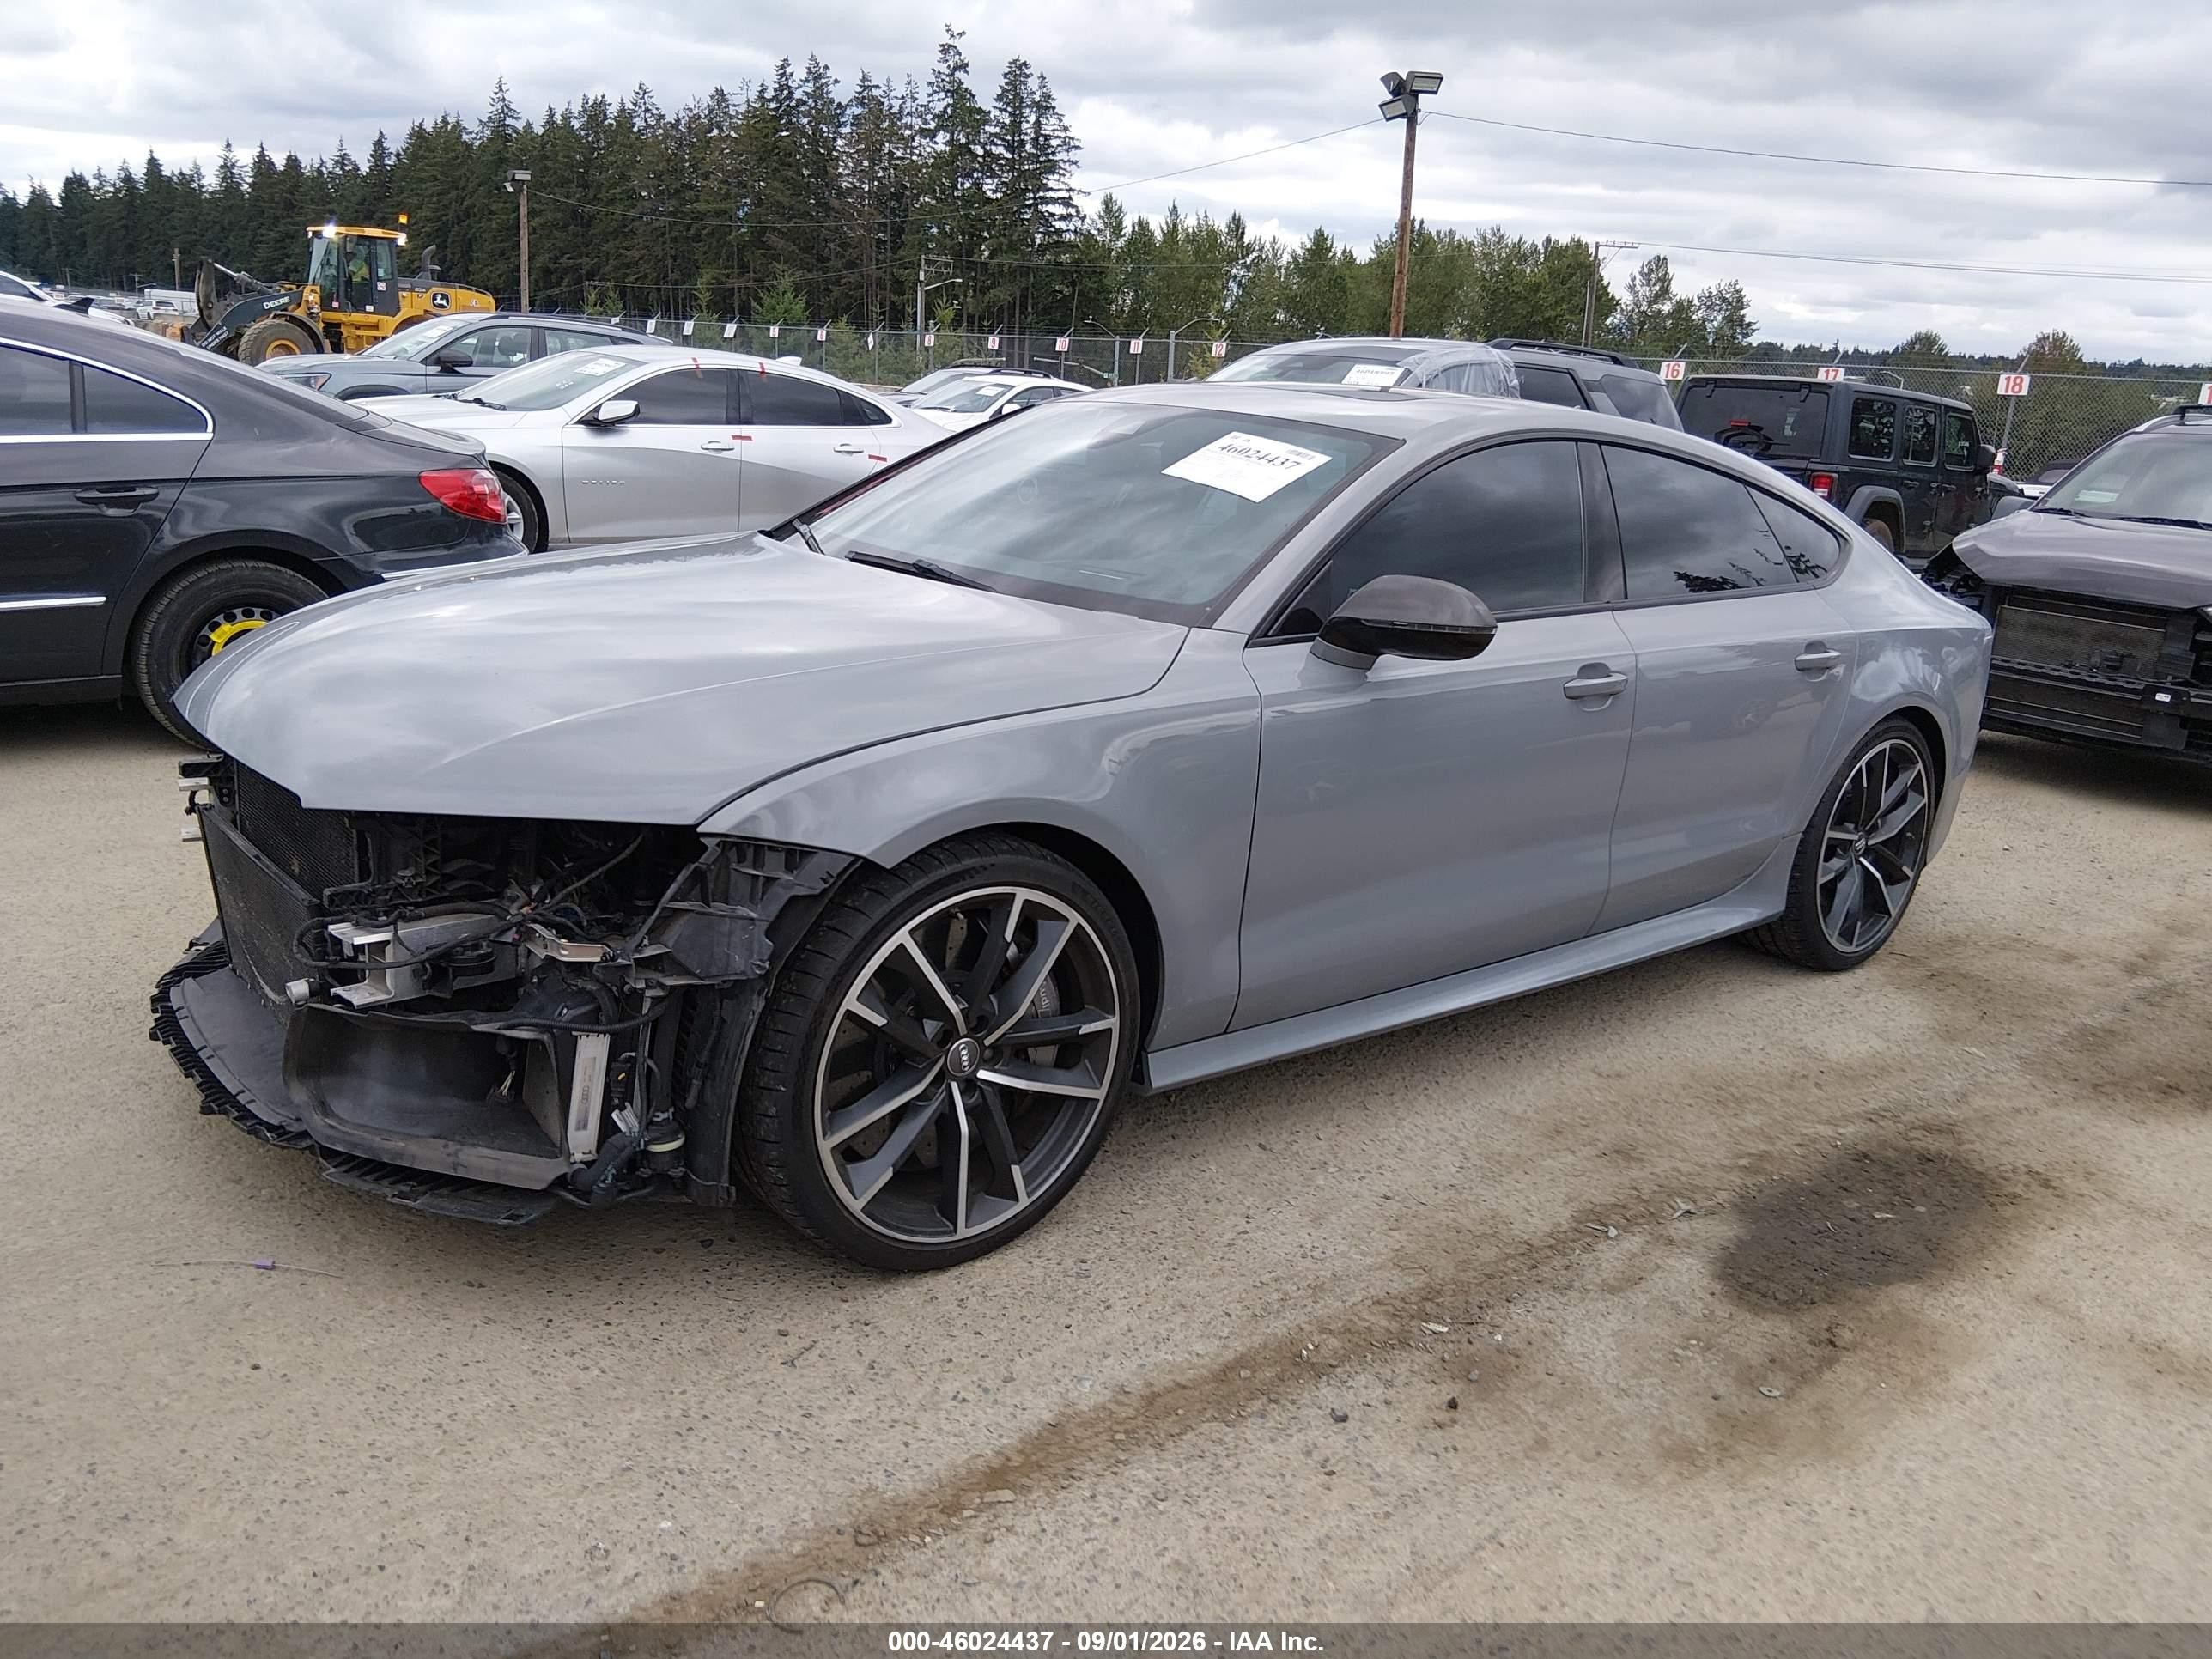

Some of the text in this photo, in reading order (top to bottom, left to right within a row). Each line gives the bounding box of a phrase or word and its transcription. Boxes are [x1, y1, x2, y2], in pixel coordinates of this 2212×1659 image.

[263, 296, 291, 309] DEERE
[1058, 339, 1067, 350] 10
[1133, 341, 1139, 352] 11
[1215, 343, 1224, 356] 12
[1664, 363, 1680, 379] 16
[1824, 368, 1838, 380] 17
[2004, 375, 2024, 394] 18
[1218, 443, 1302, 470] 46024437
